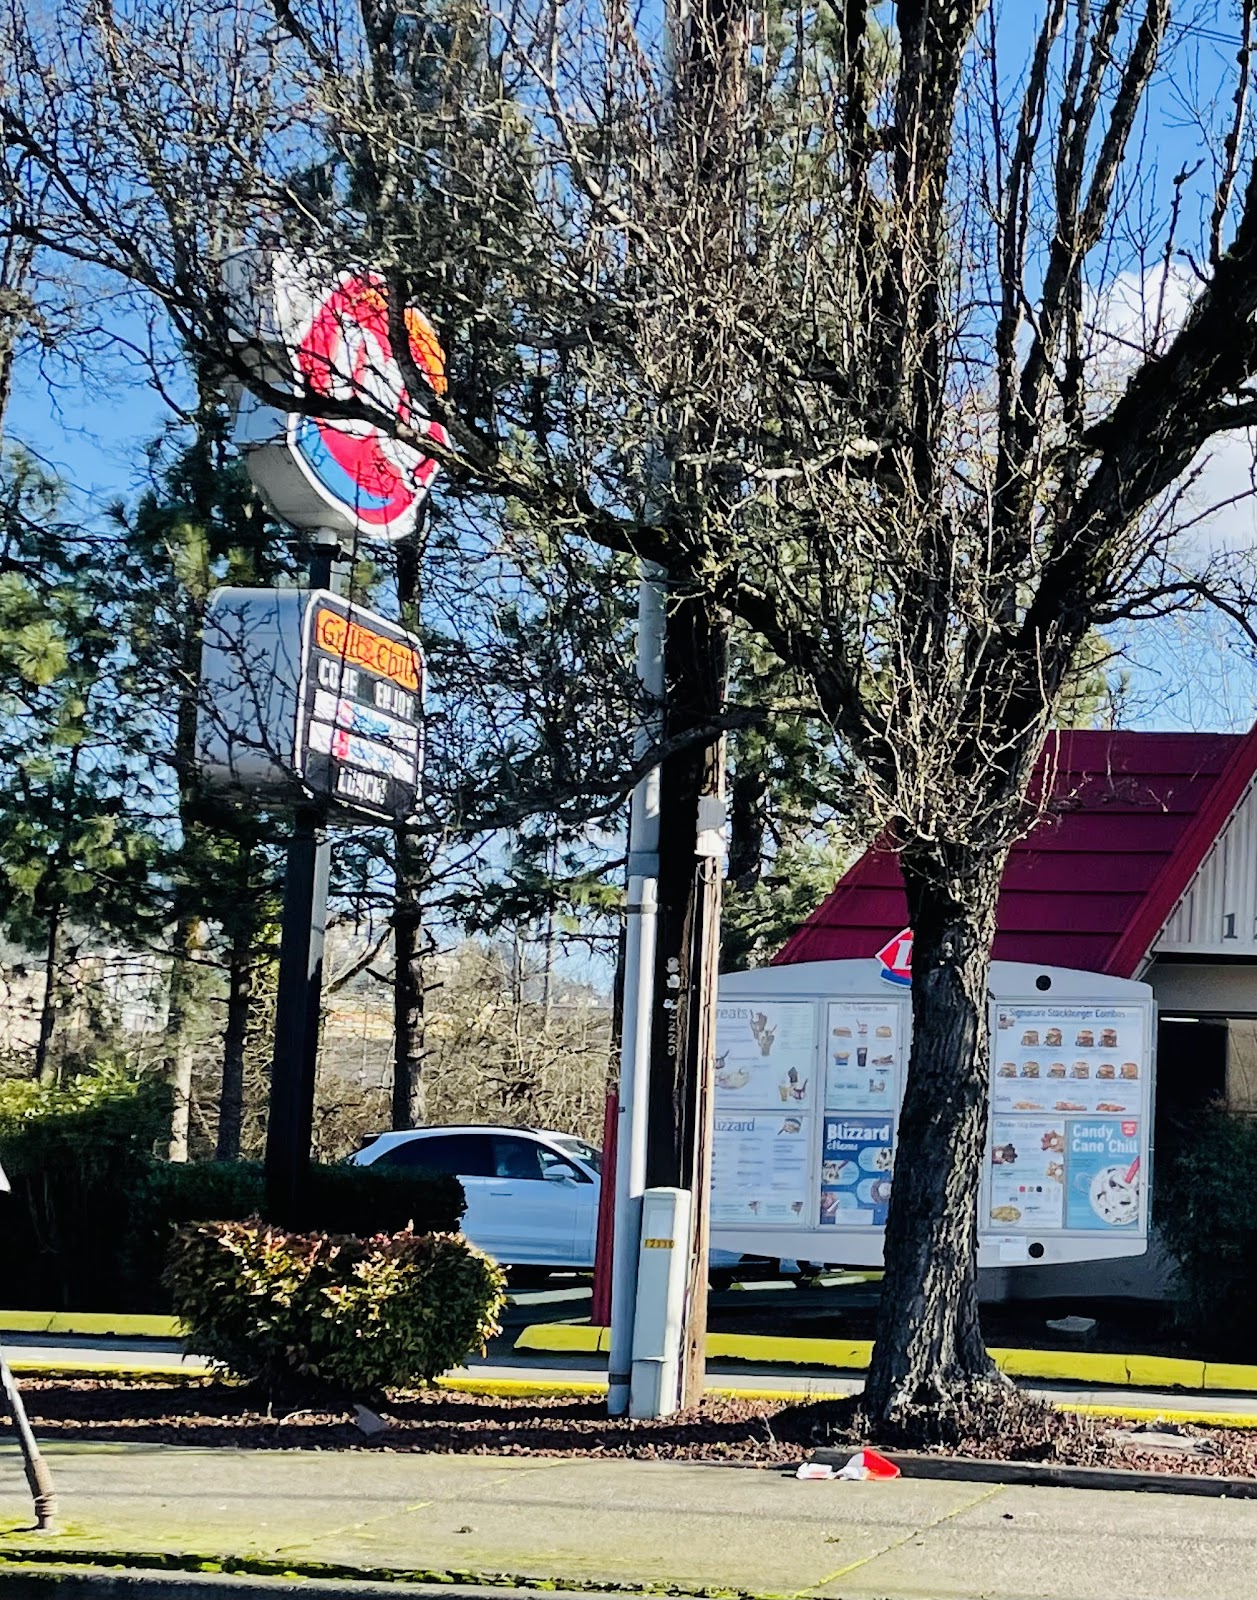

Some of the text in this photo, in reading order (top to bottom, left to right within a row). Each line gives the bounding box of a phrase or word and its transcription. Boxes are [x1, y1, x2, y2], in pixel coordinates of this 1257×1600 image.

[375, 681, 415, 720] ENJOY
[827, 1122, 890, 1141] Blizzard
[1072, 1124, 1113, 1141] Candy
[1072, 1139, 1138, 1154] Cane Chill
